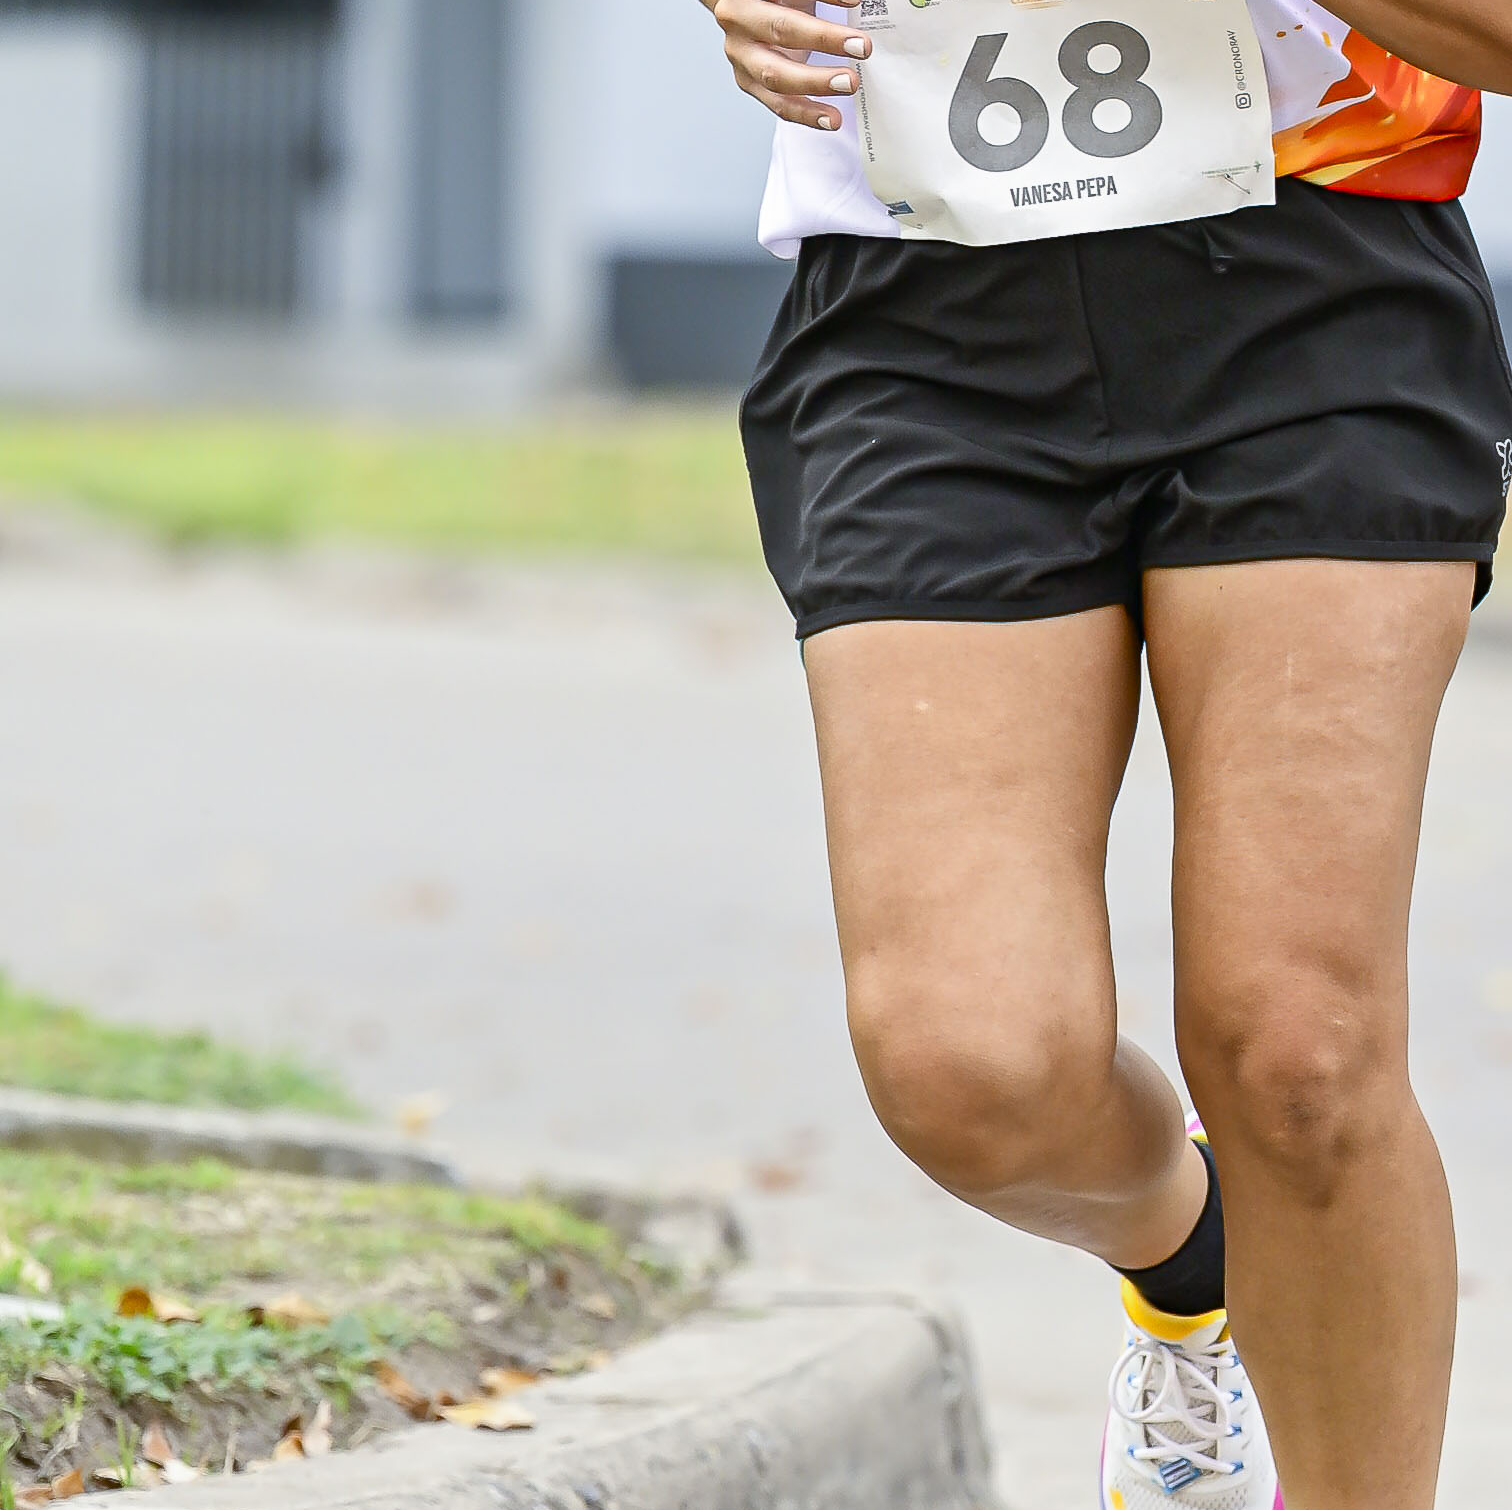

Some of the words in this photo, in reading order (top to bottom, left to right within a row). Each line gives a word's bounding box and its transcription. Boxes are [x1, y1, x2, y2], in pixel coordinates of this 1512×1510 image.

[948, 20, 1163, 172] 68
[1226, 30, 1247, 91] @CRONORAV
[855, 62, 876, 163] WWCRONORAV.COM.AR
[1009, 181, 1073, 207] VANESA
[1076, 175, 1118, 199] PEPA
